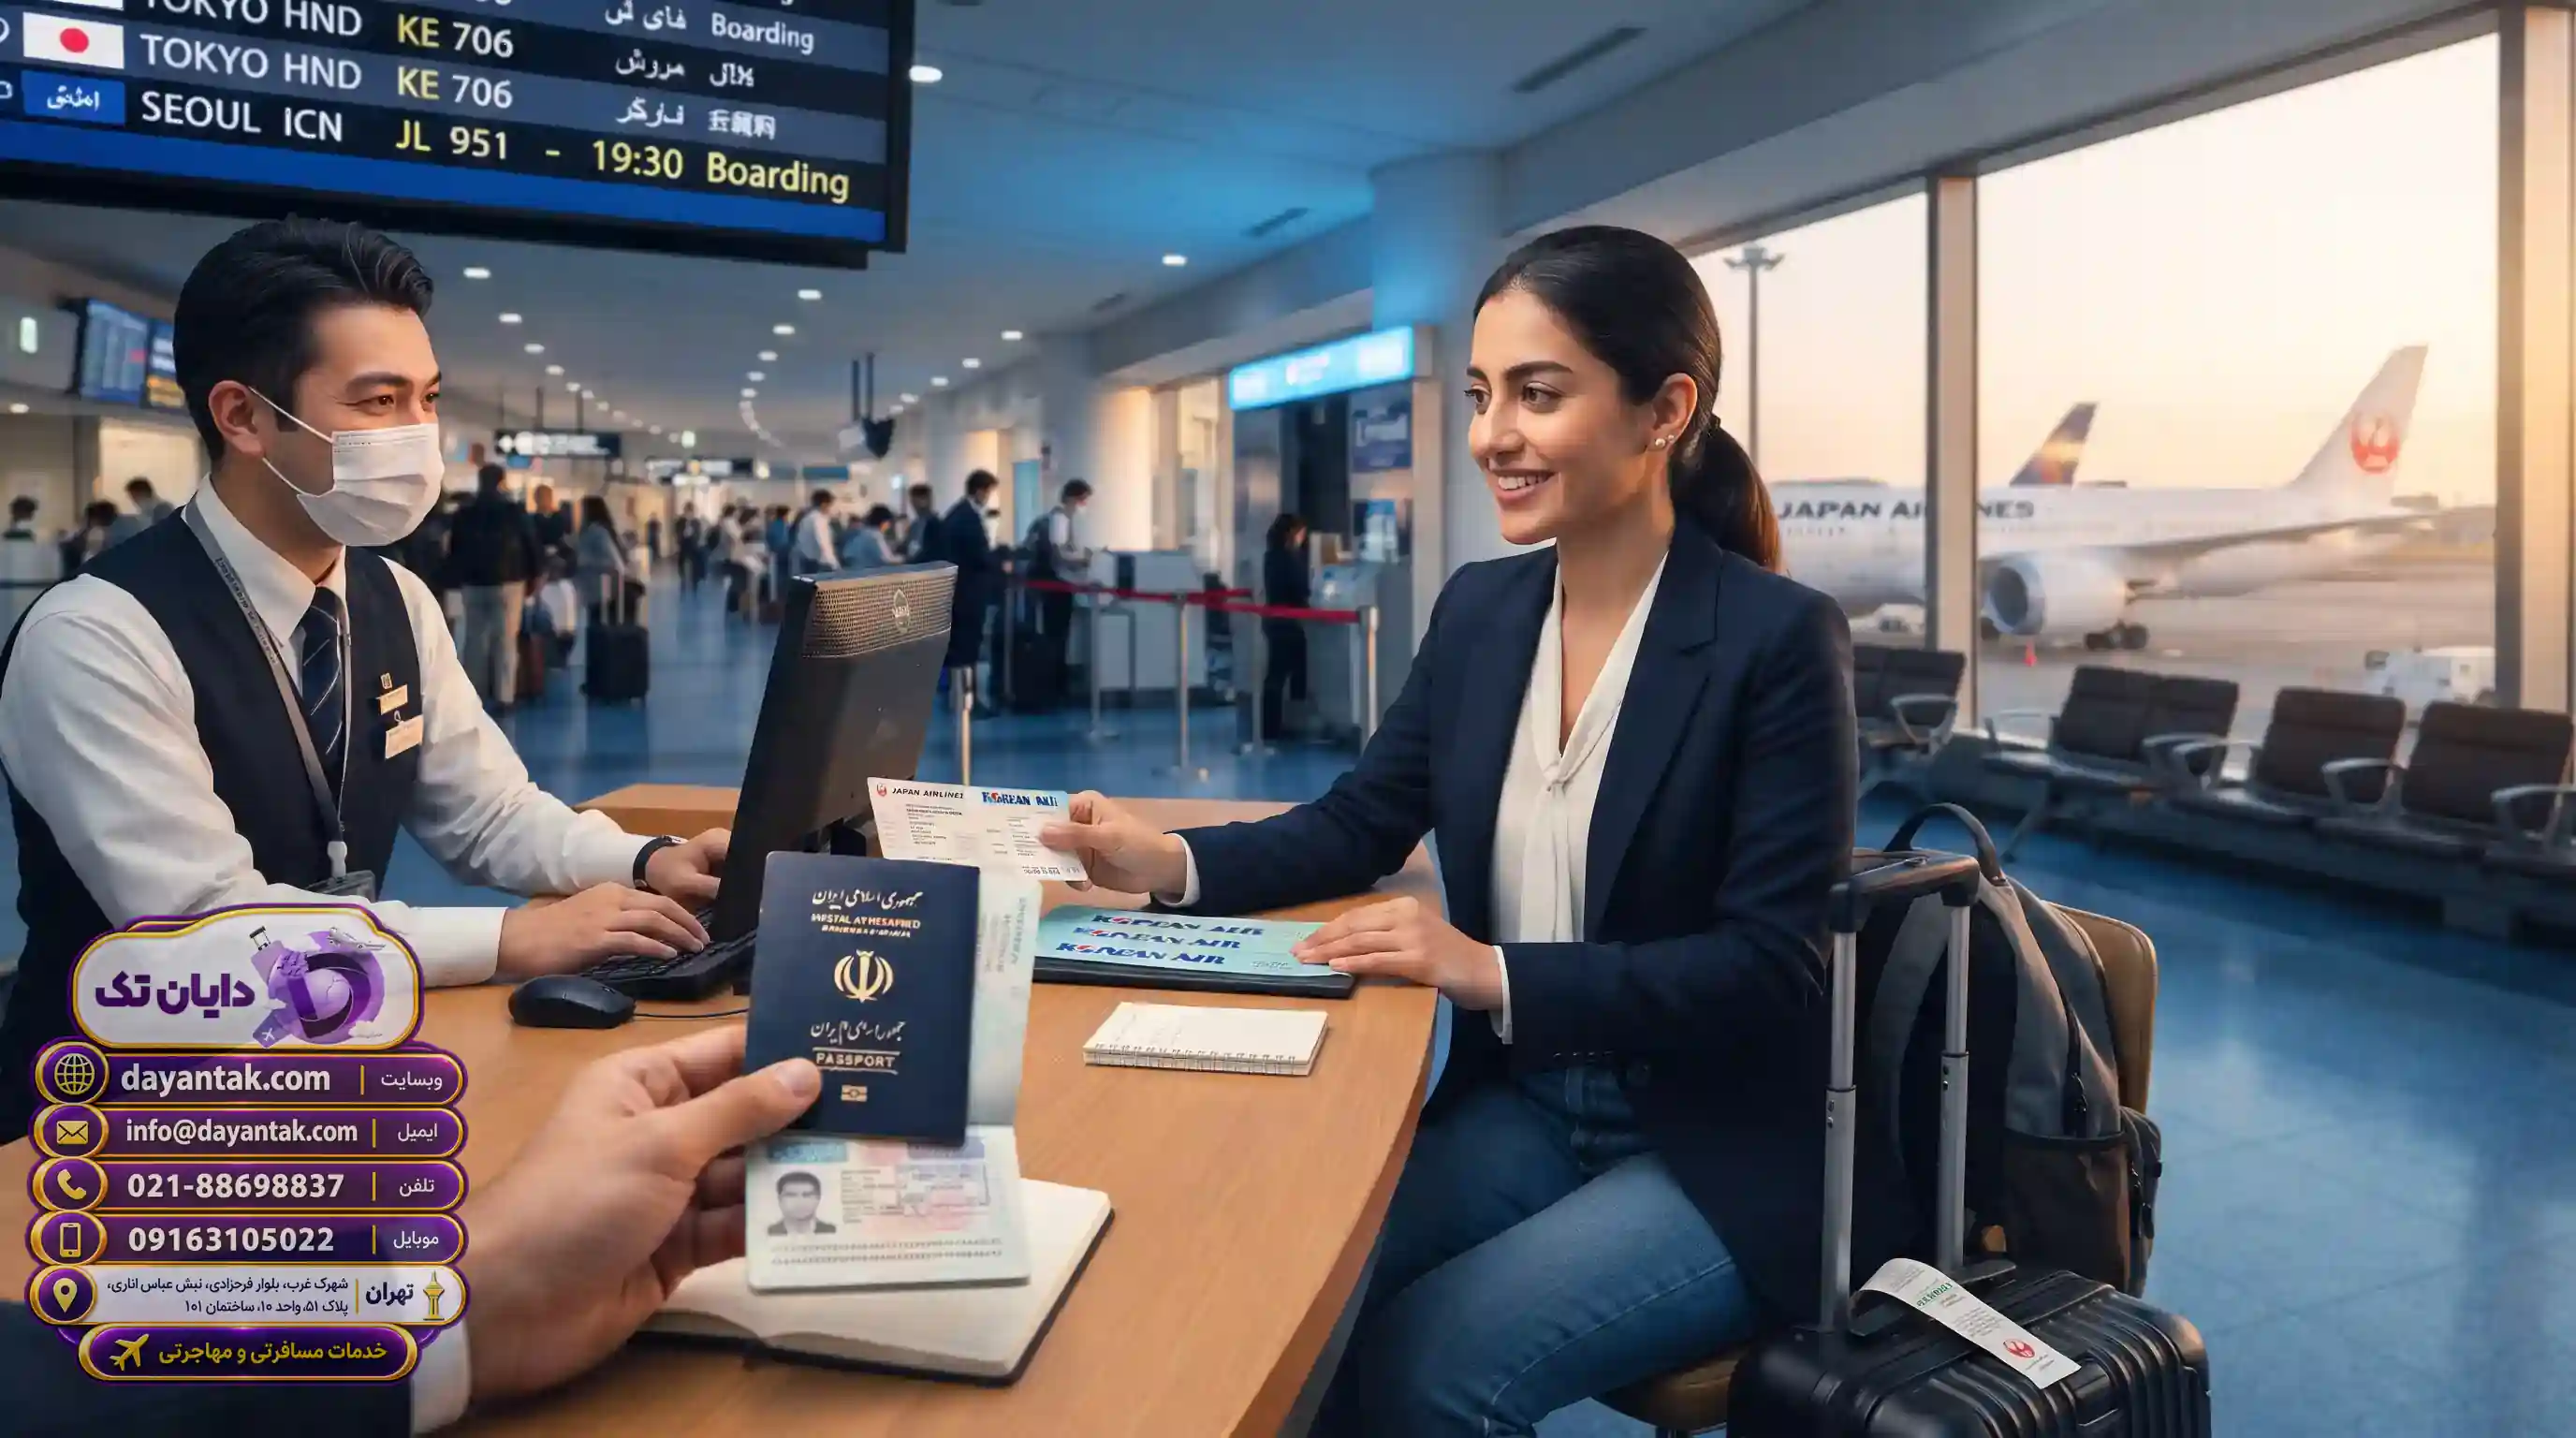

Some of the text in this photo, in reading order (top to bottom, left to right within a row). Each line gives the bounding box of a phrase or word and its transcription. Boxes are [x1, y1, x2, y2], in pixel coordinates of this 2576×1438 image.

[147, 0, 362, 37] KYO HND
[397, 13, 514, 58] KE 706
[711, 12, 814, 55] Boarding
[139, 34, 362, 89] TOKYO HND
[397, 66, 514, 109] KE 706
[141, 91, 343, 142] SEOUL ICN
[396, 121, 432, 152] JL
[450, 126, 508, 160] 951
[593, 140, 683, 179] 19:30
[708, 152, 850, 203] Boarding
[1778, 501, 1882, 521] JAPAN
[892, 787, 920, 796] JAPAN
[1170, 951, 1226, 965] AIR
[1188, 937, 1241, 949] AIR
[816, 1052, 896, 1067] PASSPORT
